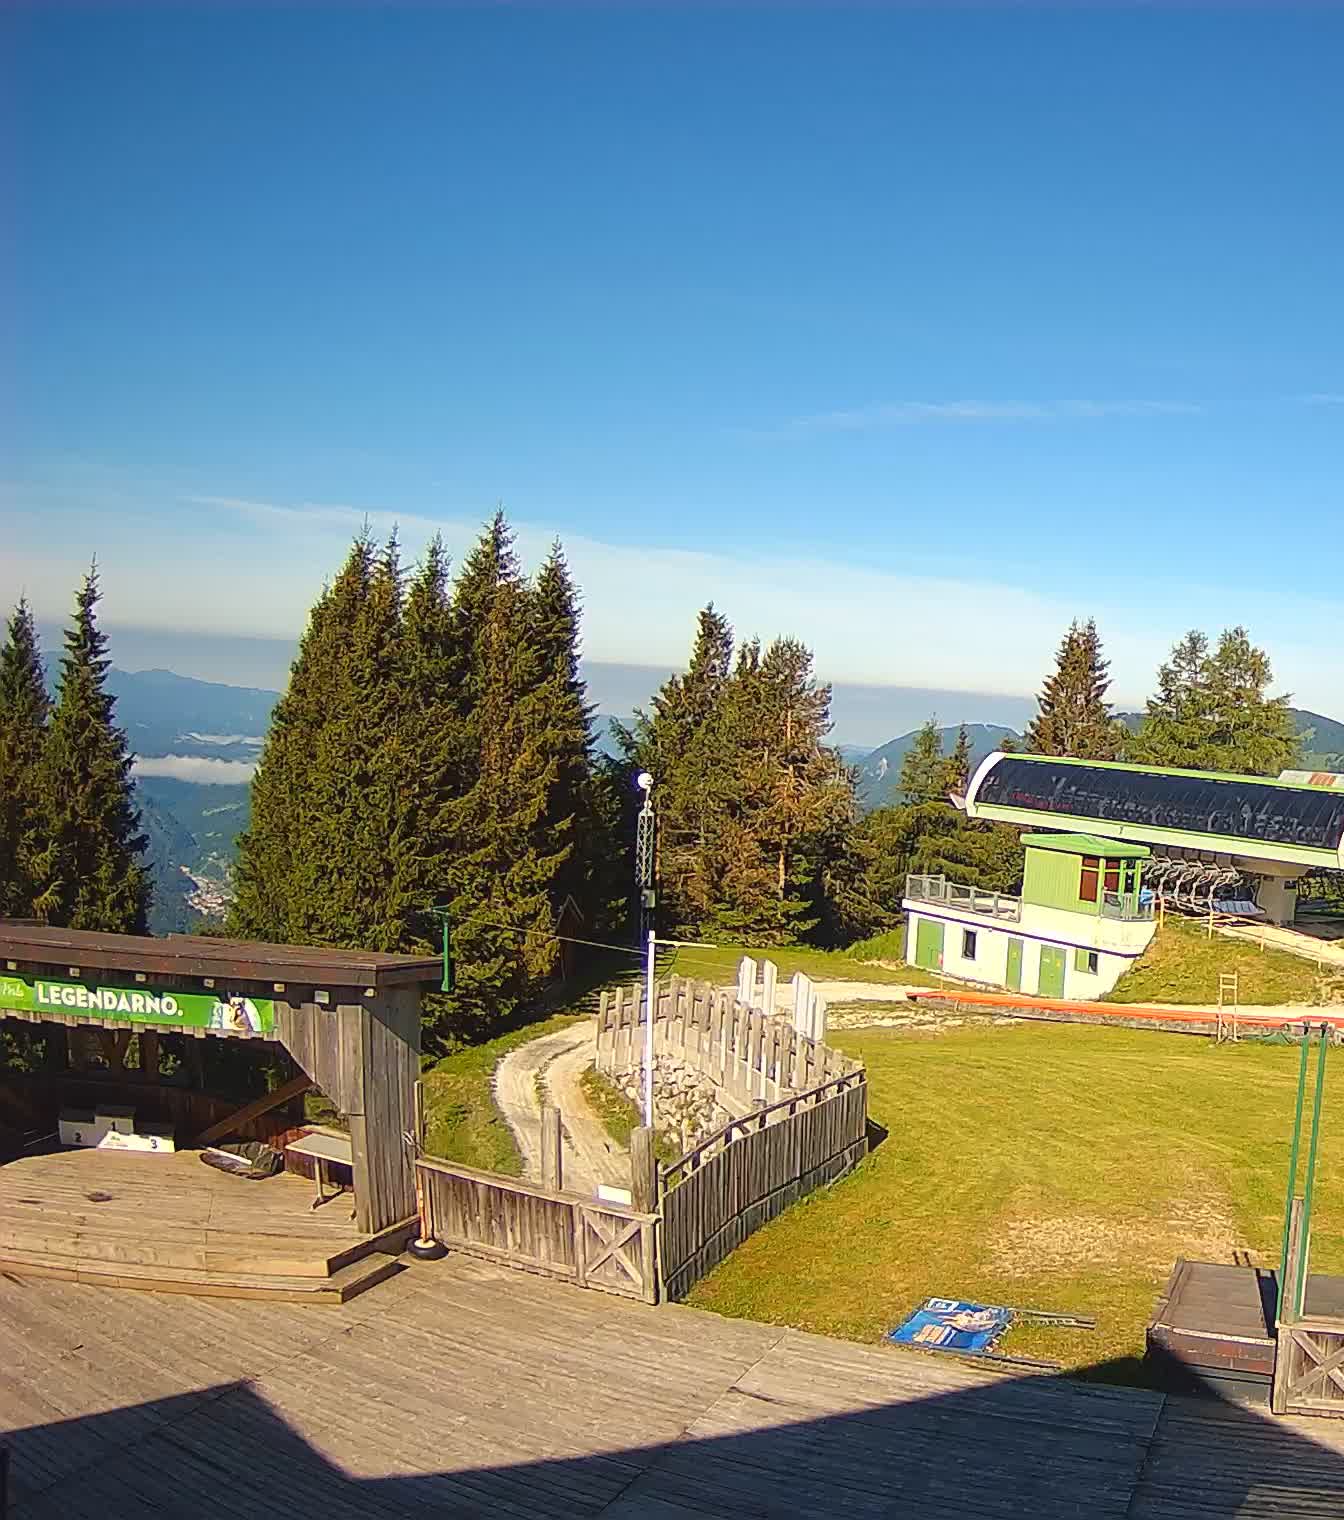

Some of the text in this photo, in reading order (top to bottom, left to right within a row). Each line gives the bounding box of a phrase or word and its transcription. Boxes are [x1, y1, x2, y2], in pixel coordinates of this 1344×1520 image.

[37, 983, 184, 1017] LEGENDARNO.
[74, 1131, 82, 1142] 2
[149, 1138, 158, 1149] 3
